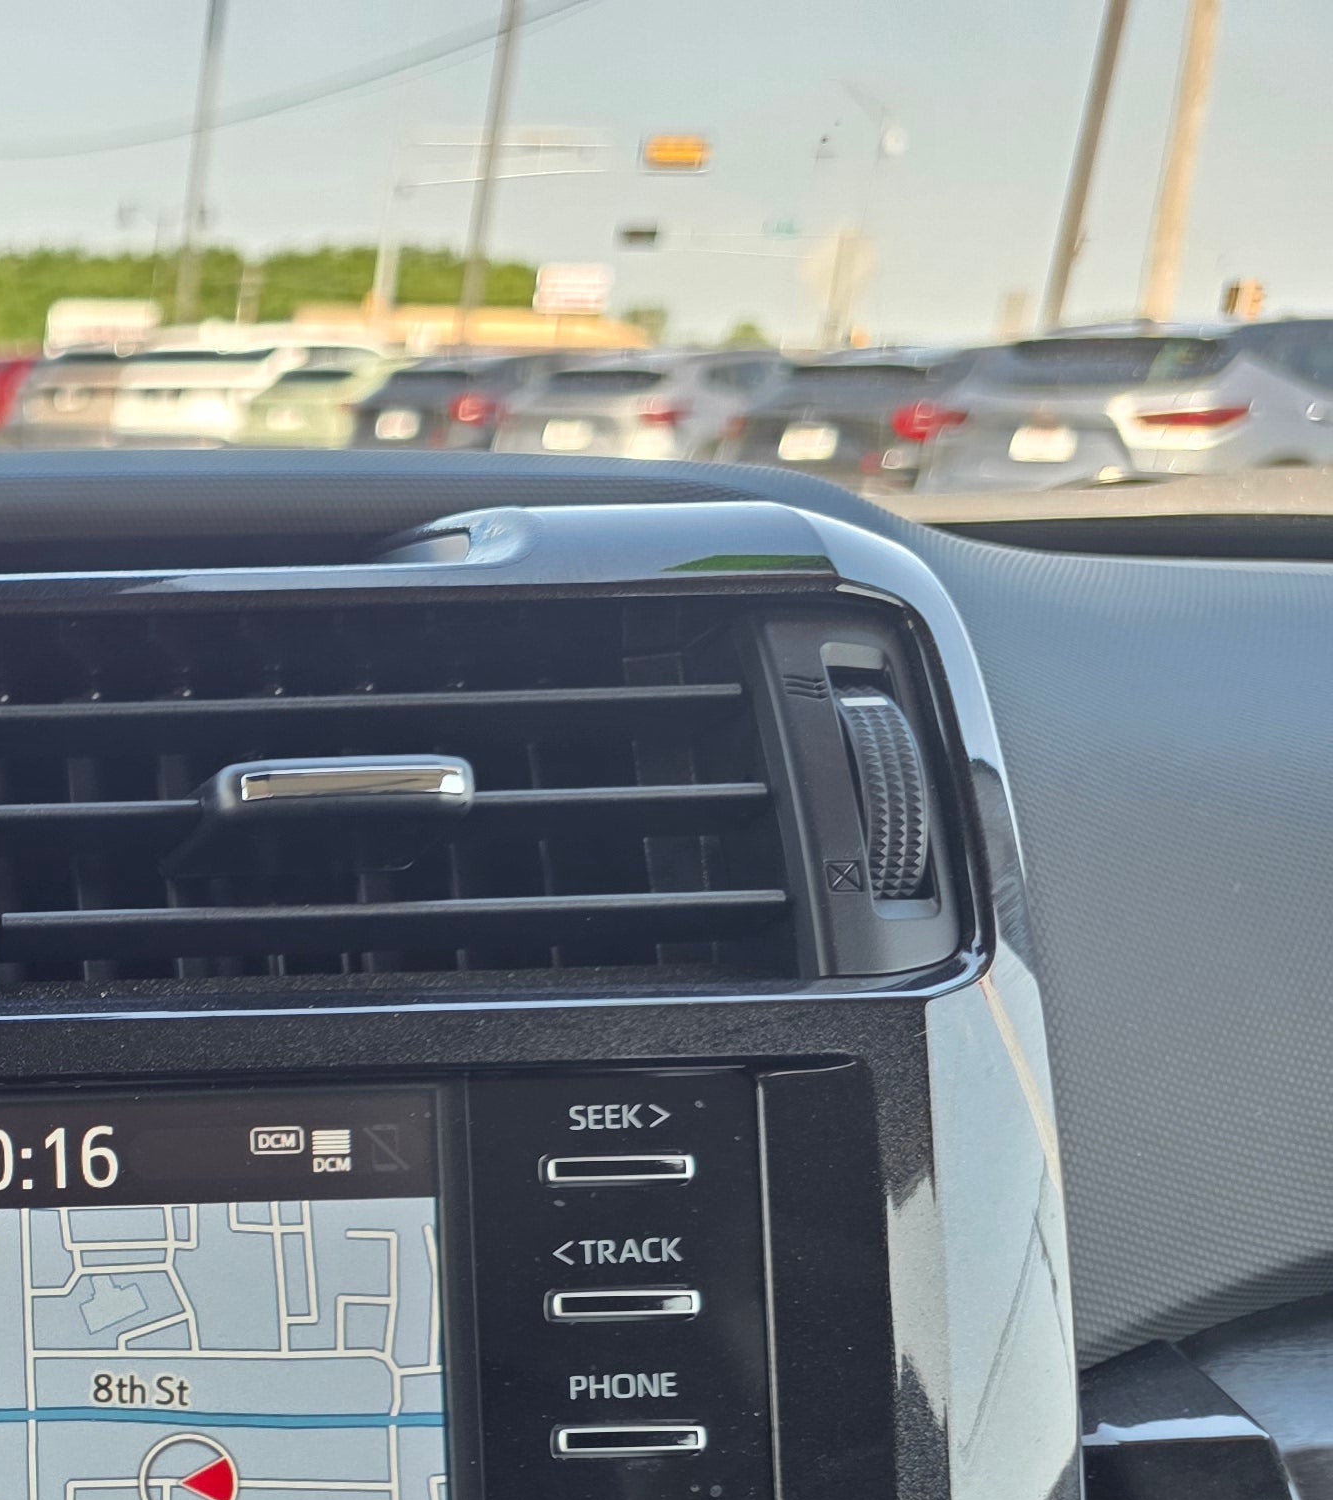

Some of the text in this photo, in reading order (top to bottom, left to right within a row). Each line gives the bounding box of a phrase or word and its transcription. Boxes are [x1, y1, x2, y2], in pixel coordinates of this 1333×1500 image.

[569, 1104, 642, 1130] SEEK
[257, 1131, 296, 1150] DCM
[313, 1157, 351, 1172] DCM
[579, 1238, 682, 1264] TRACK
[93, 1374, 188, 1406] 8th St
[570, 1372, 677, 1399] PHONE
